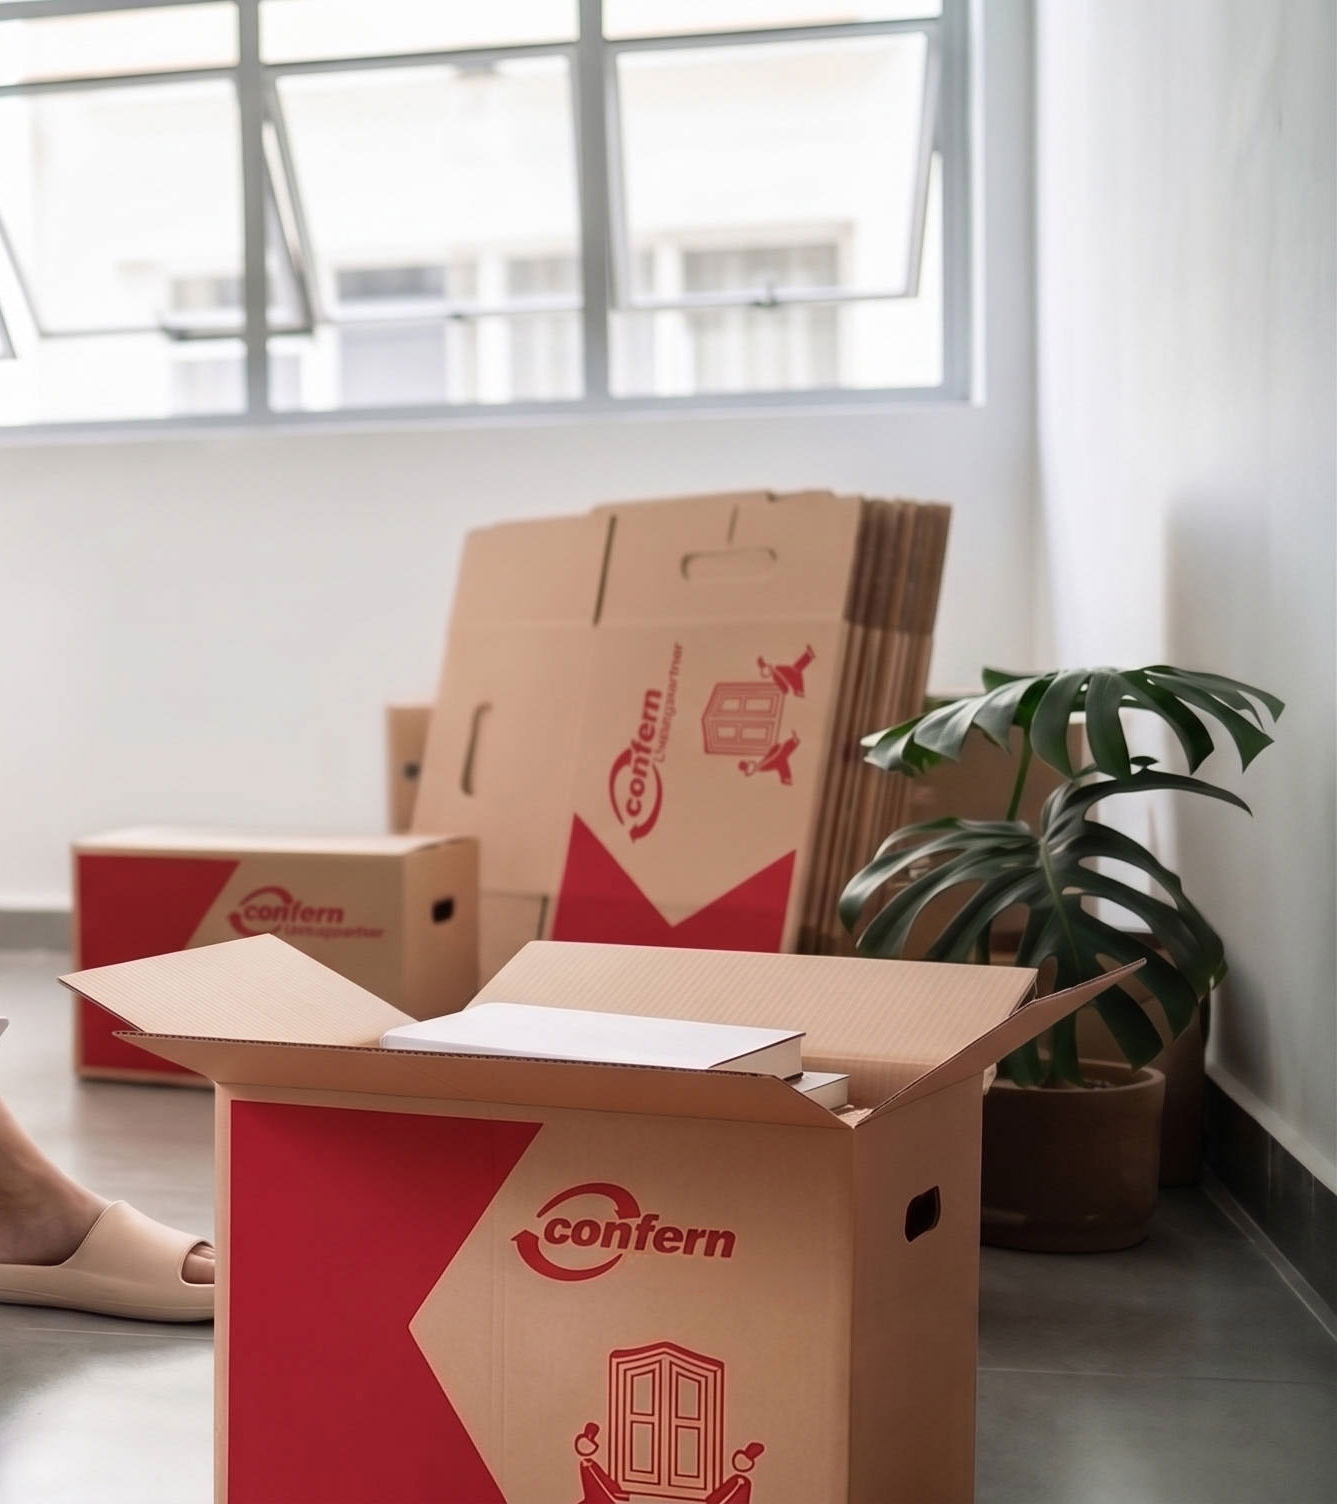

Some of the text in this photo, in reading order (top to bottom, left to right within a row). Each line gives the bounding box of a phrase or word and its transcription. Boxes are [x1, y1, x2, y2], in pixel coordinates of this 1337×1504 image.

[626, 688, 663, 817] confern
[243, 900, 345, 924] confern
[544, 1213, 736, 1258] confern
